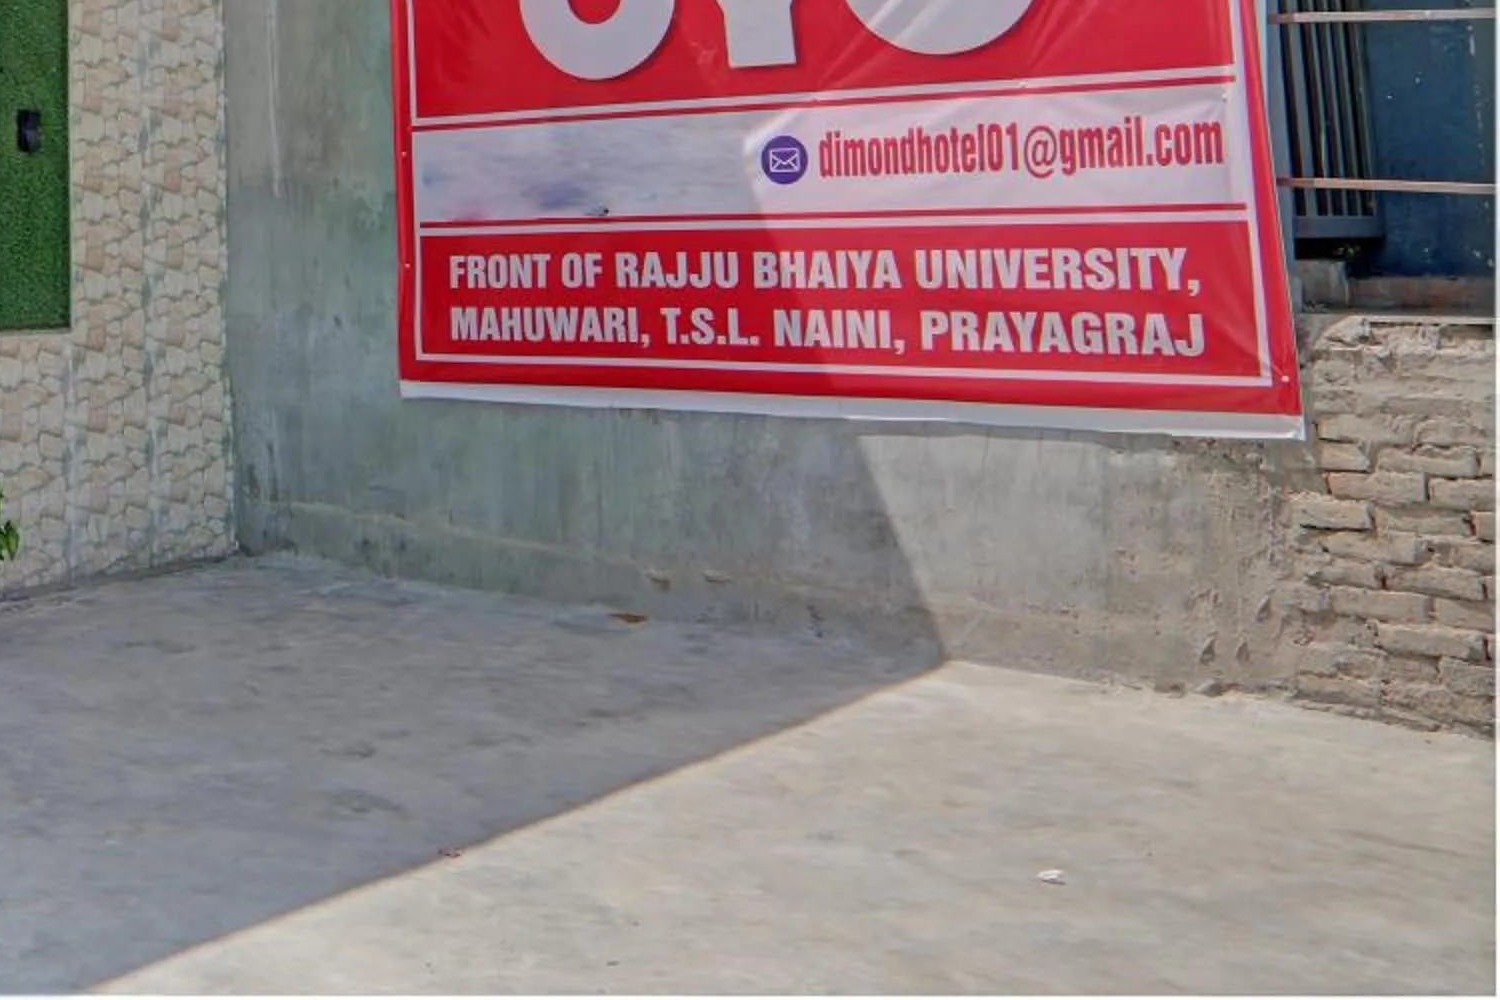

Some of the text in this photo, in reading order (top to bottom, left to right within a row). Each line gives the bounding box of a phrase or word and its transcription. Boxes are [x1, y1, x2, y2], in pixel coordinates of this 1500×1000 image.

[818, 116, 1225, 180] dimondhotel01@gmail.com
[449, 247, 1201, 297] FRONT OF RAJJU BHAIYA UNIVERSITY,
[450, 306, 1204, 357] MAHUWARI, T.S.L. NAINI, PRAYAGRAJ
